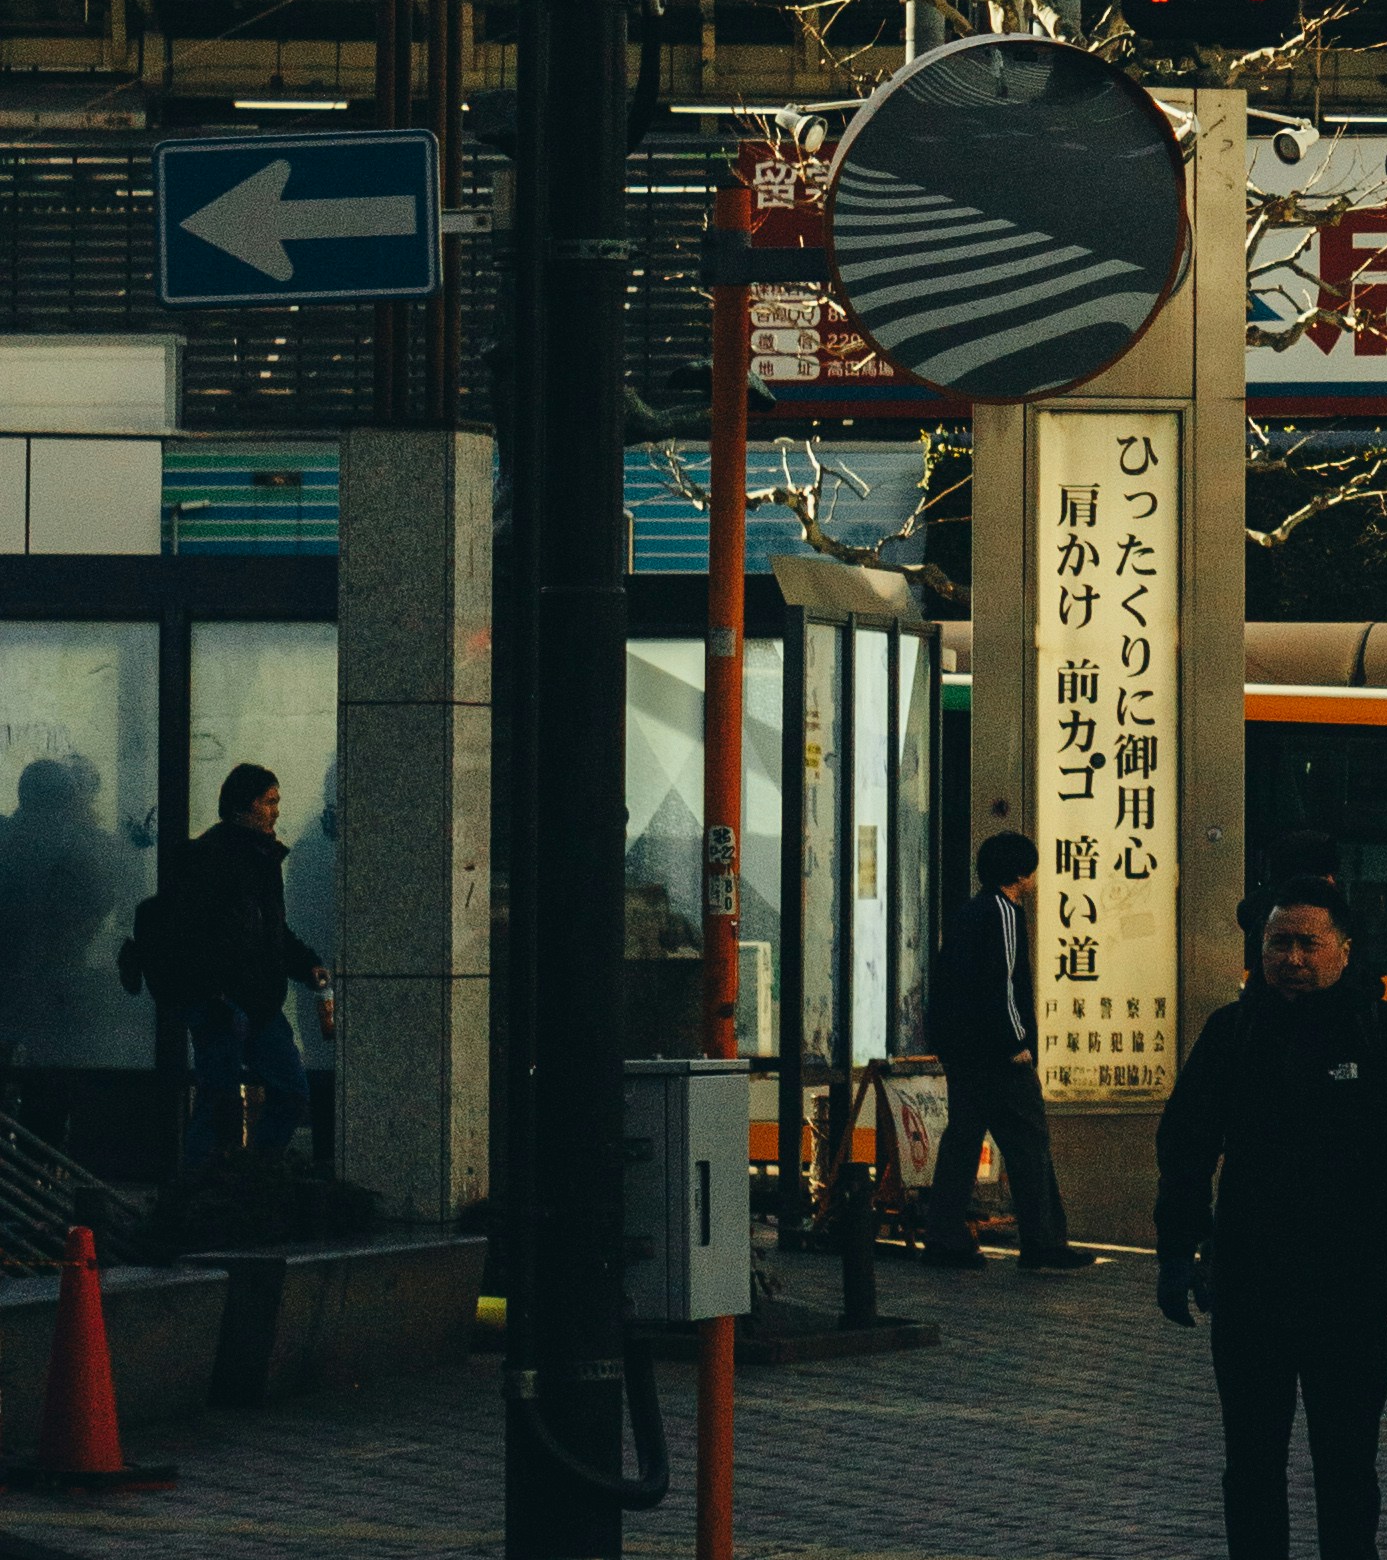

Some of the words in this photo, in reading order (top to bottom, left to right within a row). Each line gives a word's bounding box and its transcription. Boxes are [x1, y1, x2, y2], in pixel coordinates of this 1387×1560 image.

[1056, 483, 1101, 630] 肩かけ
[1113, 434, 1158, 881] ひったくりに御用心
[1054, 834, 1100, 984] 暗い道
